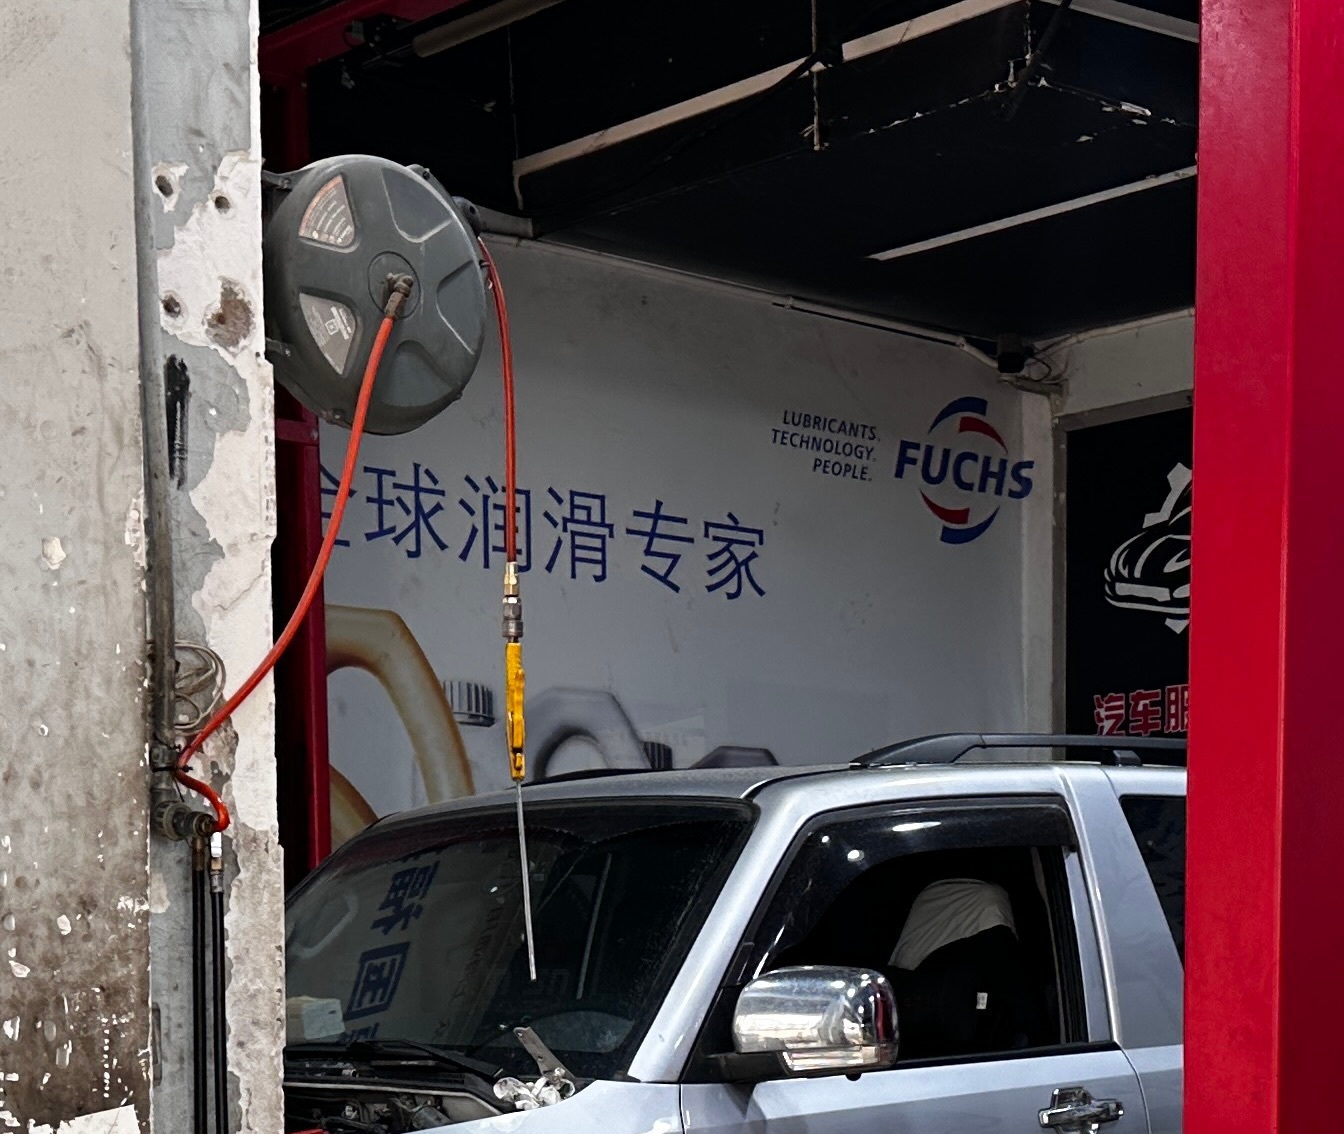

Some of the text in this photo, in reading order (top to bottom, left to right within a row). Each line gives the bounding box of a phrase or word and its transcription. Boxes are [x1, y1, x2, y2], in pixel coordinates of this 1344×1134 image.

[783, 409, 880, 443] LUBRICANTS.
[771, 428, 877, 463] TECHNOLOGY.
[813, 457, 873, 483] PEOPLE.
[894, 439, 1035, 500] FUCHS
